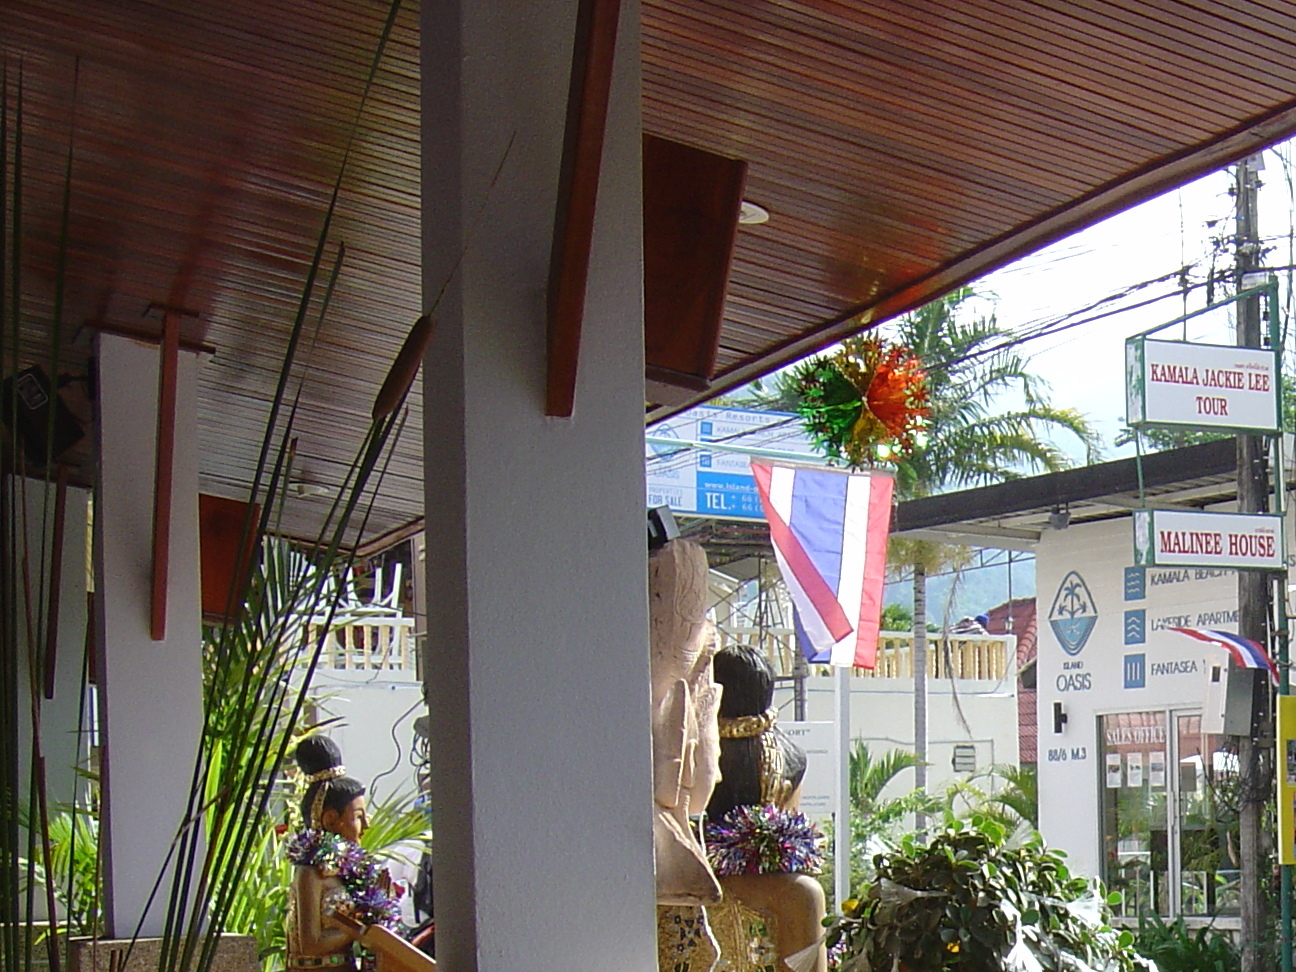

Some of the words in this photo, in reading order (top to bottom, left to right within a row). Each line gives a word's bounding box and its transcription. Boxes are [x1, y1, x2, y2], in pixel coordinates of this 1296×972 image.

[1150, 363, 1199, 385] KAMALA
[1202, 369, 1244, 389] JACKIE
[1248, 372, 1270, 392] LEE
[1196, 396, 1228, 416] TOUR
[725, 411, 769, 423] Resorts
[649, 494, 663, 505] FOR
[665, 495, 682, 507] SALE
[705, 492, 731, 510] TEL.
[1160, 531, 1222, 555] MALINEE
[1229, 533, 1275, 557] HOUSE
[1151, 569, 1190, 586] KAMALA
[1151, 660, 1197, 676] FANTASEA
[1056, 673, 1092, 691] OASIS
[1106, 728, 1133, 745] SALES
[1135, 726, 1166, 743] OFFICE
